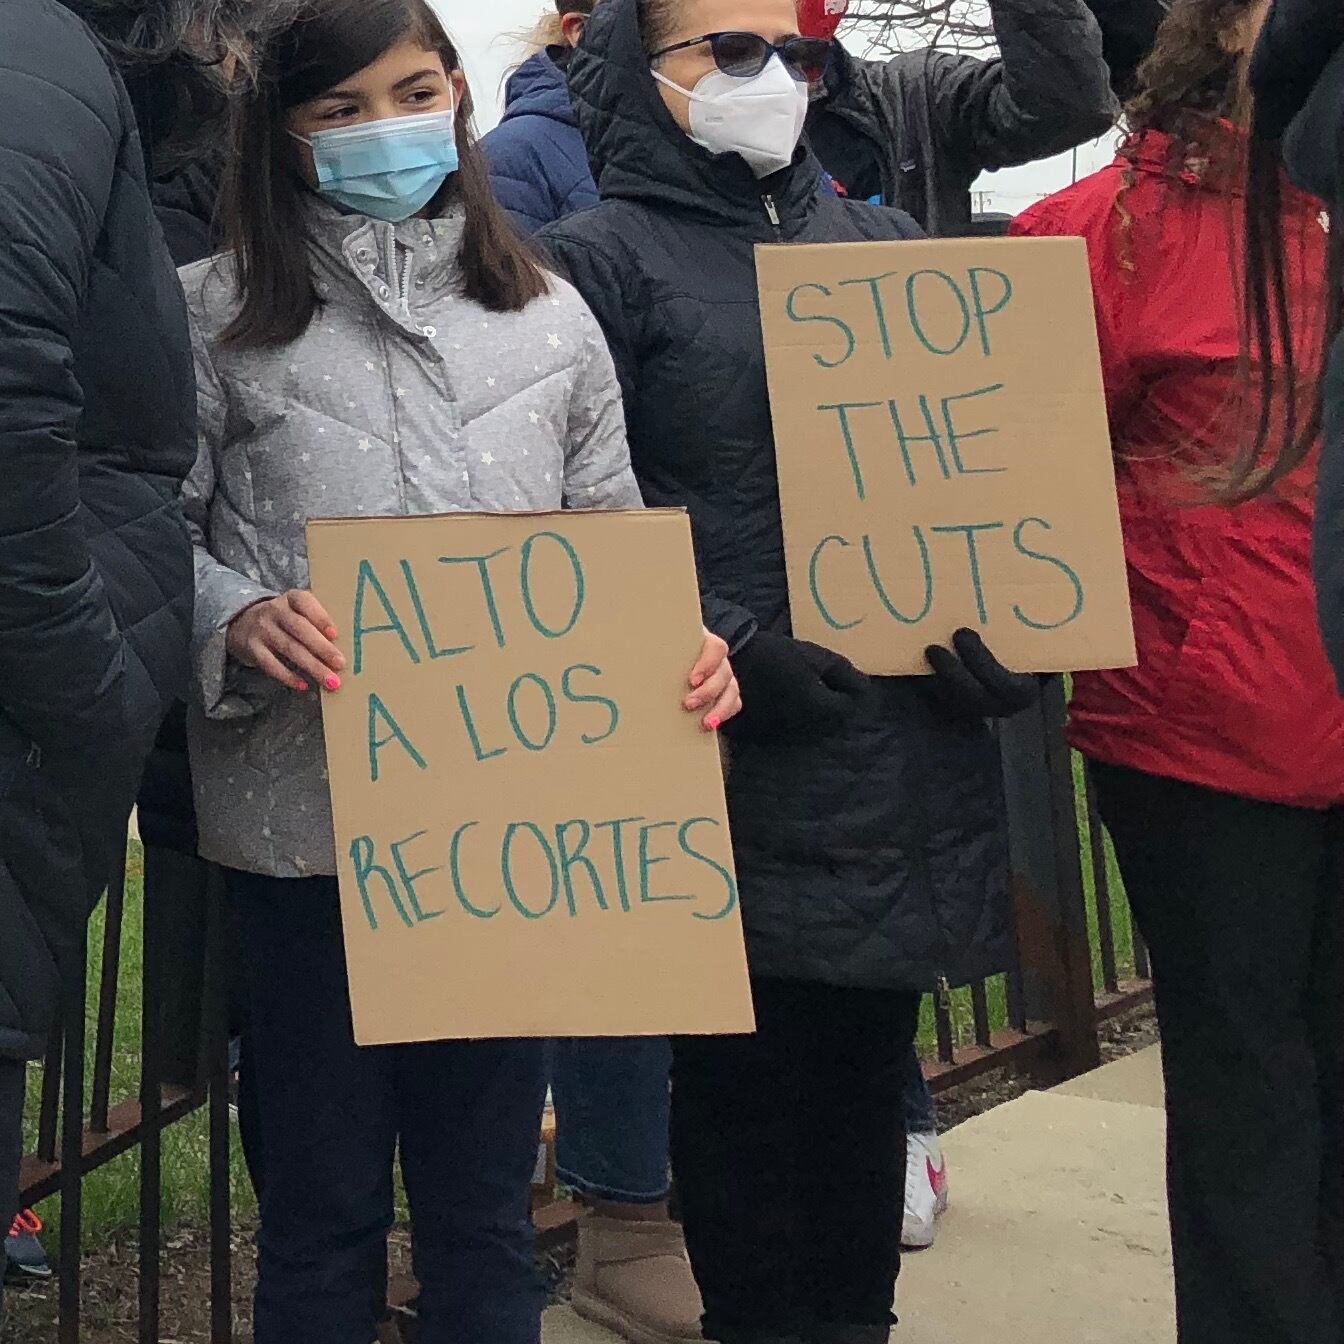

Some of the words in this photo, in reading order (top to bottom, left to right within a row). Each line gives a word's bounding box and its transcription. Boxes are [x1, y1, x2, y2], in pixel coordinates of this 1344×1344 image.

[786, 268, 1012, 367] STOP
[817, 383, 1008, 501] THE
[353, 531, 585, 676] ALTO
[809, 517, 1084, 629] CUTS
[368, 693, 428, 782] A
[456, 664, 619, 761] LOS
[348, 817, 738, 931] RECORTES
